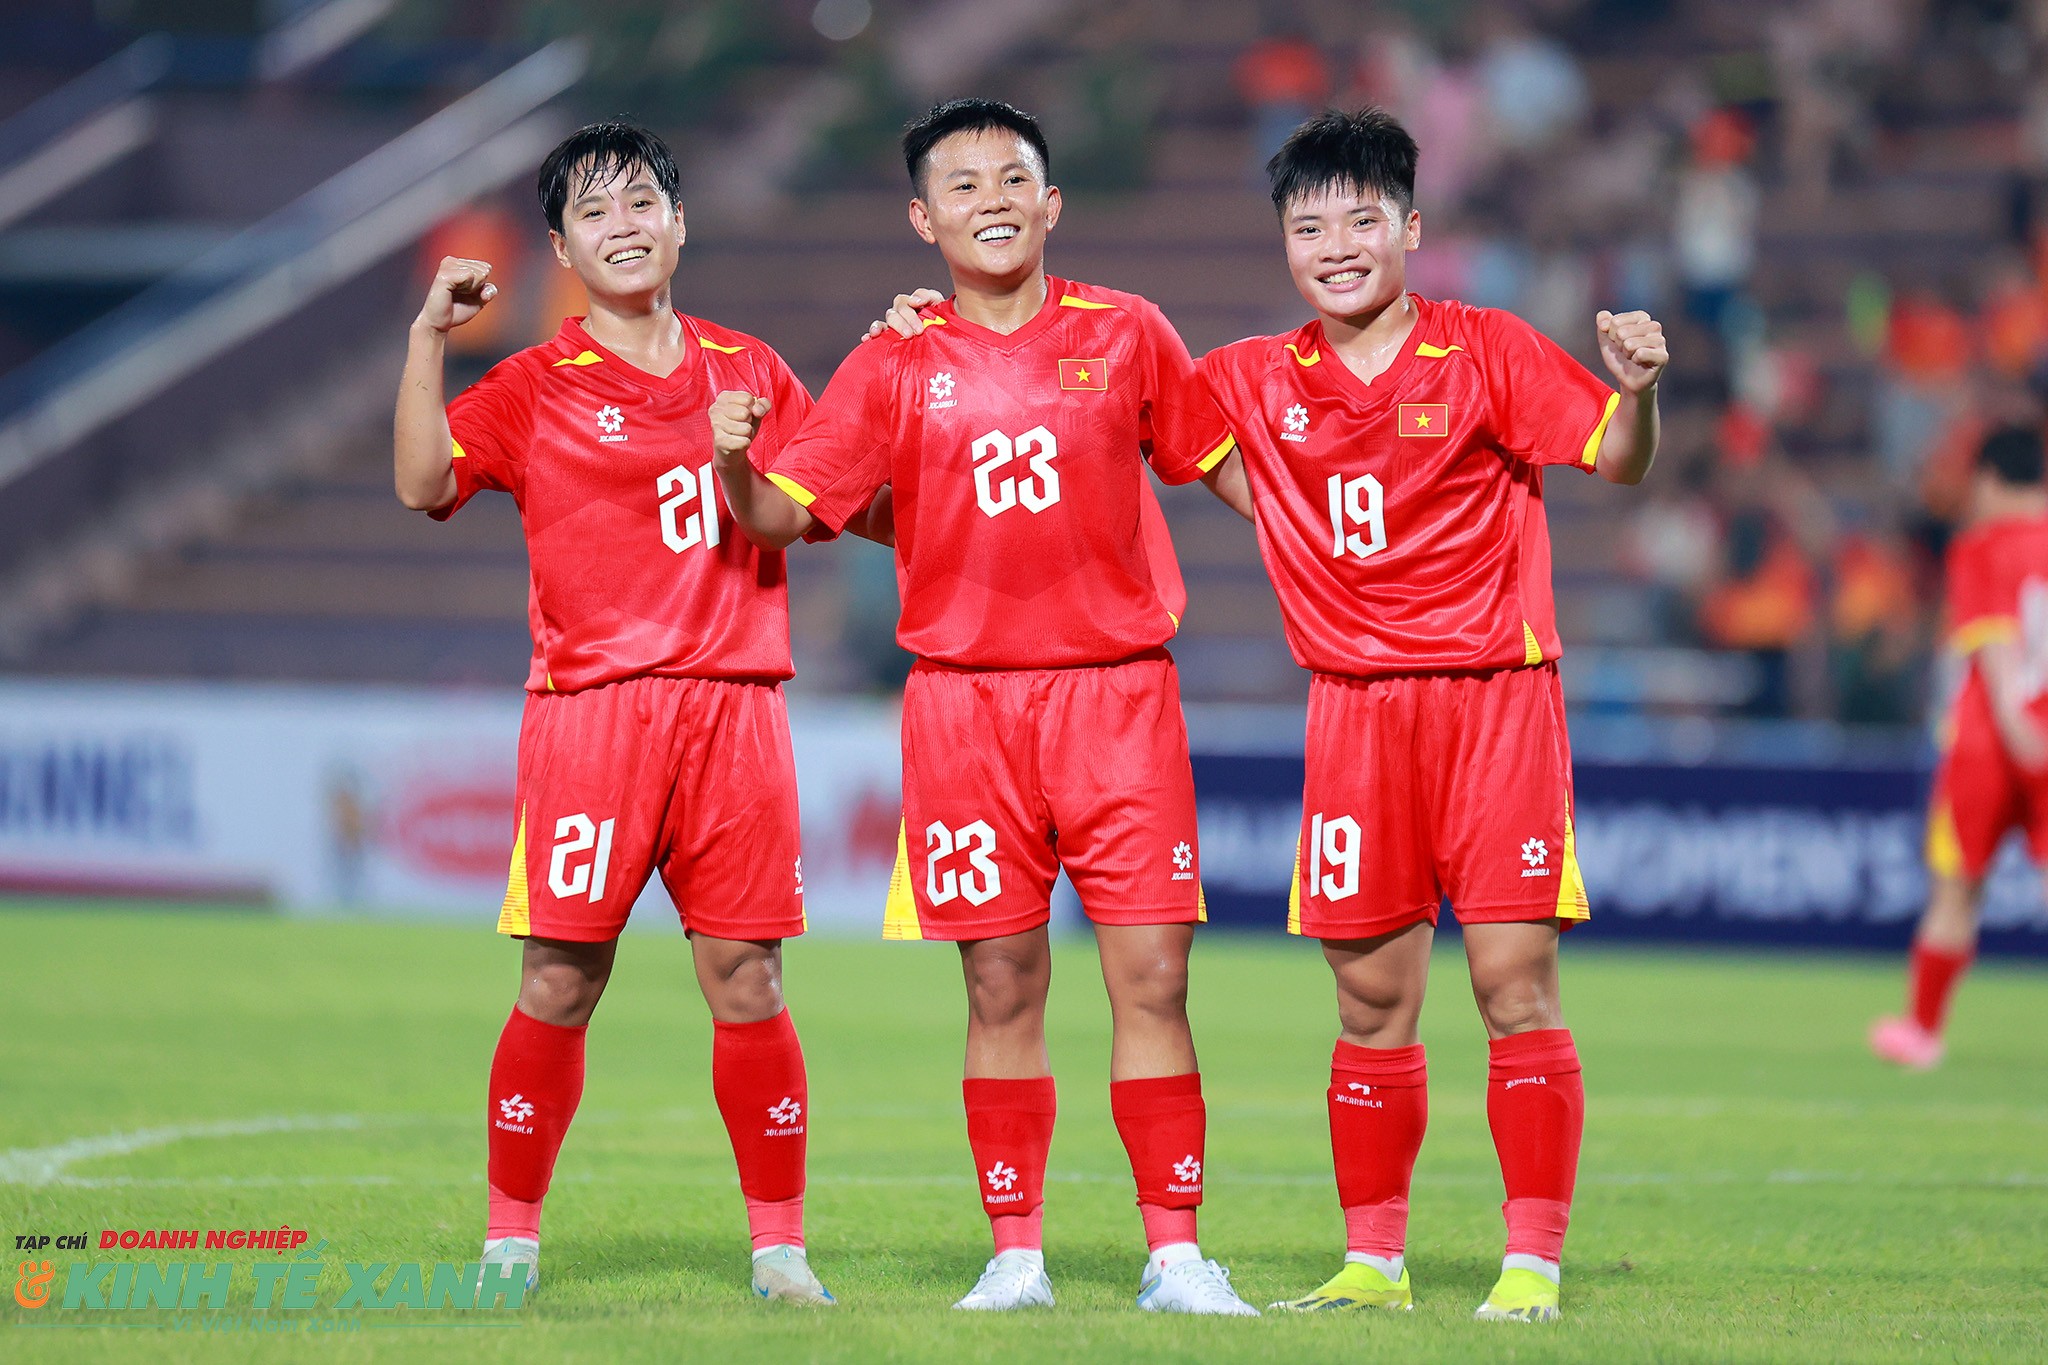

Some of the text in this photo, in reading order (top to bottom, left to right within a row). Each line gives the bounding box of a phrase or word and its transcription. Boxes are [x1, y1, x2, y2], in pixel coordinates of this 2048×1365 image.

[656, 461, 721, 554] 21
[971, 424, 1061, 519] 23
[1327, 472, 1388, 559] 19
[547, 812, 616, 904] 21
[925, 819, 1002, 907] 23
[1310, 812, 1362, 903] 19
